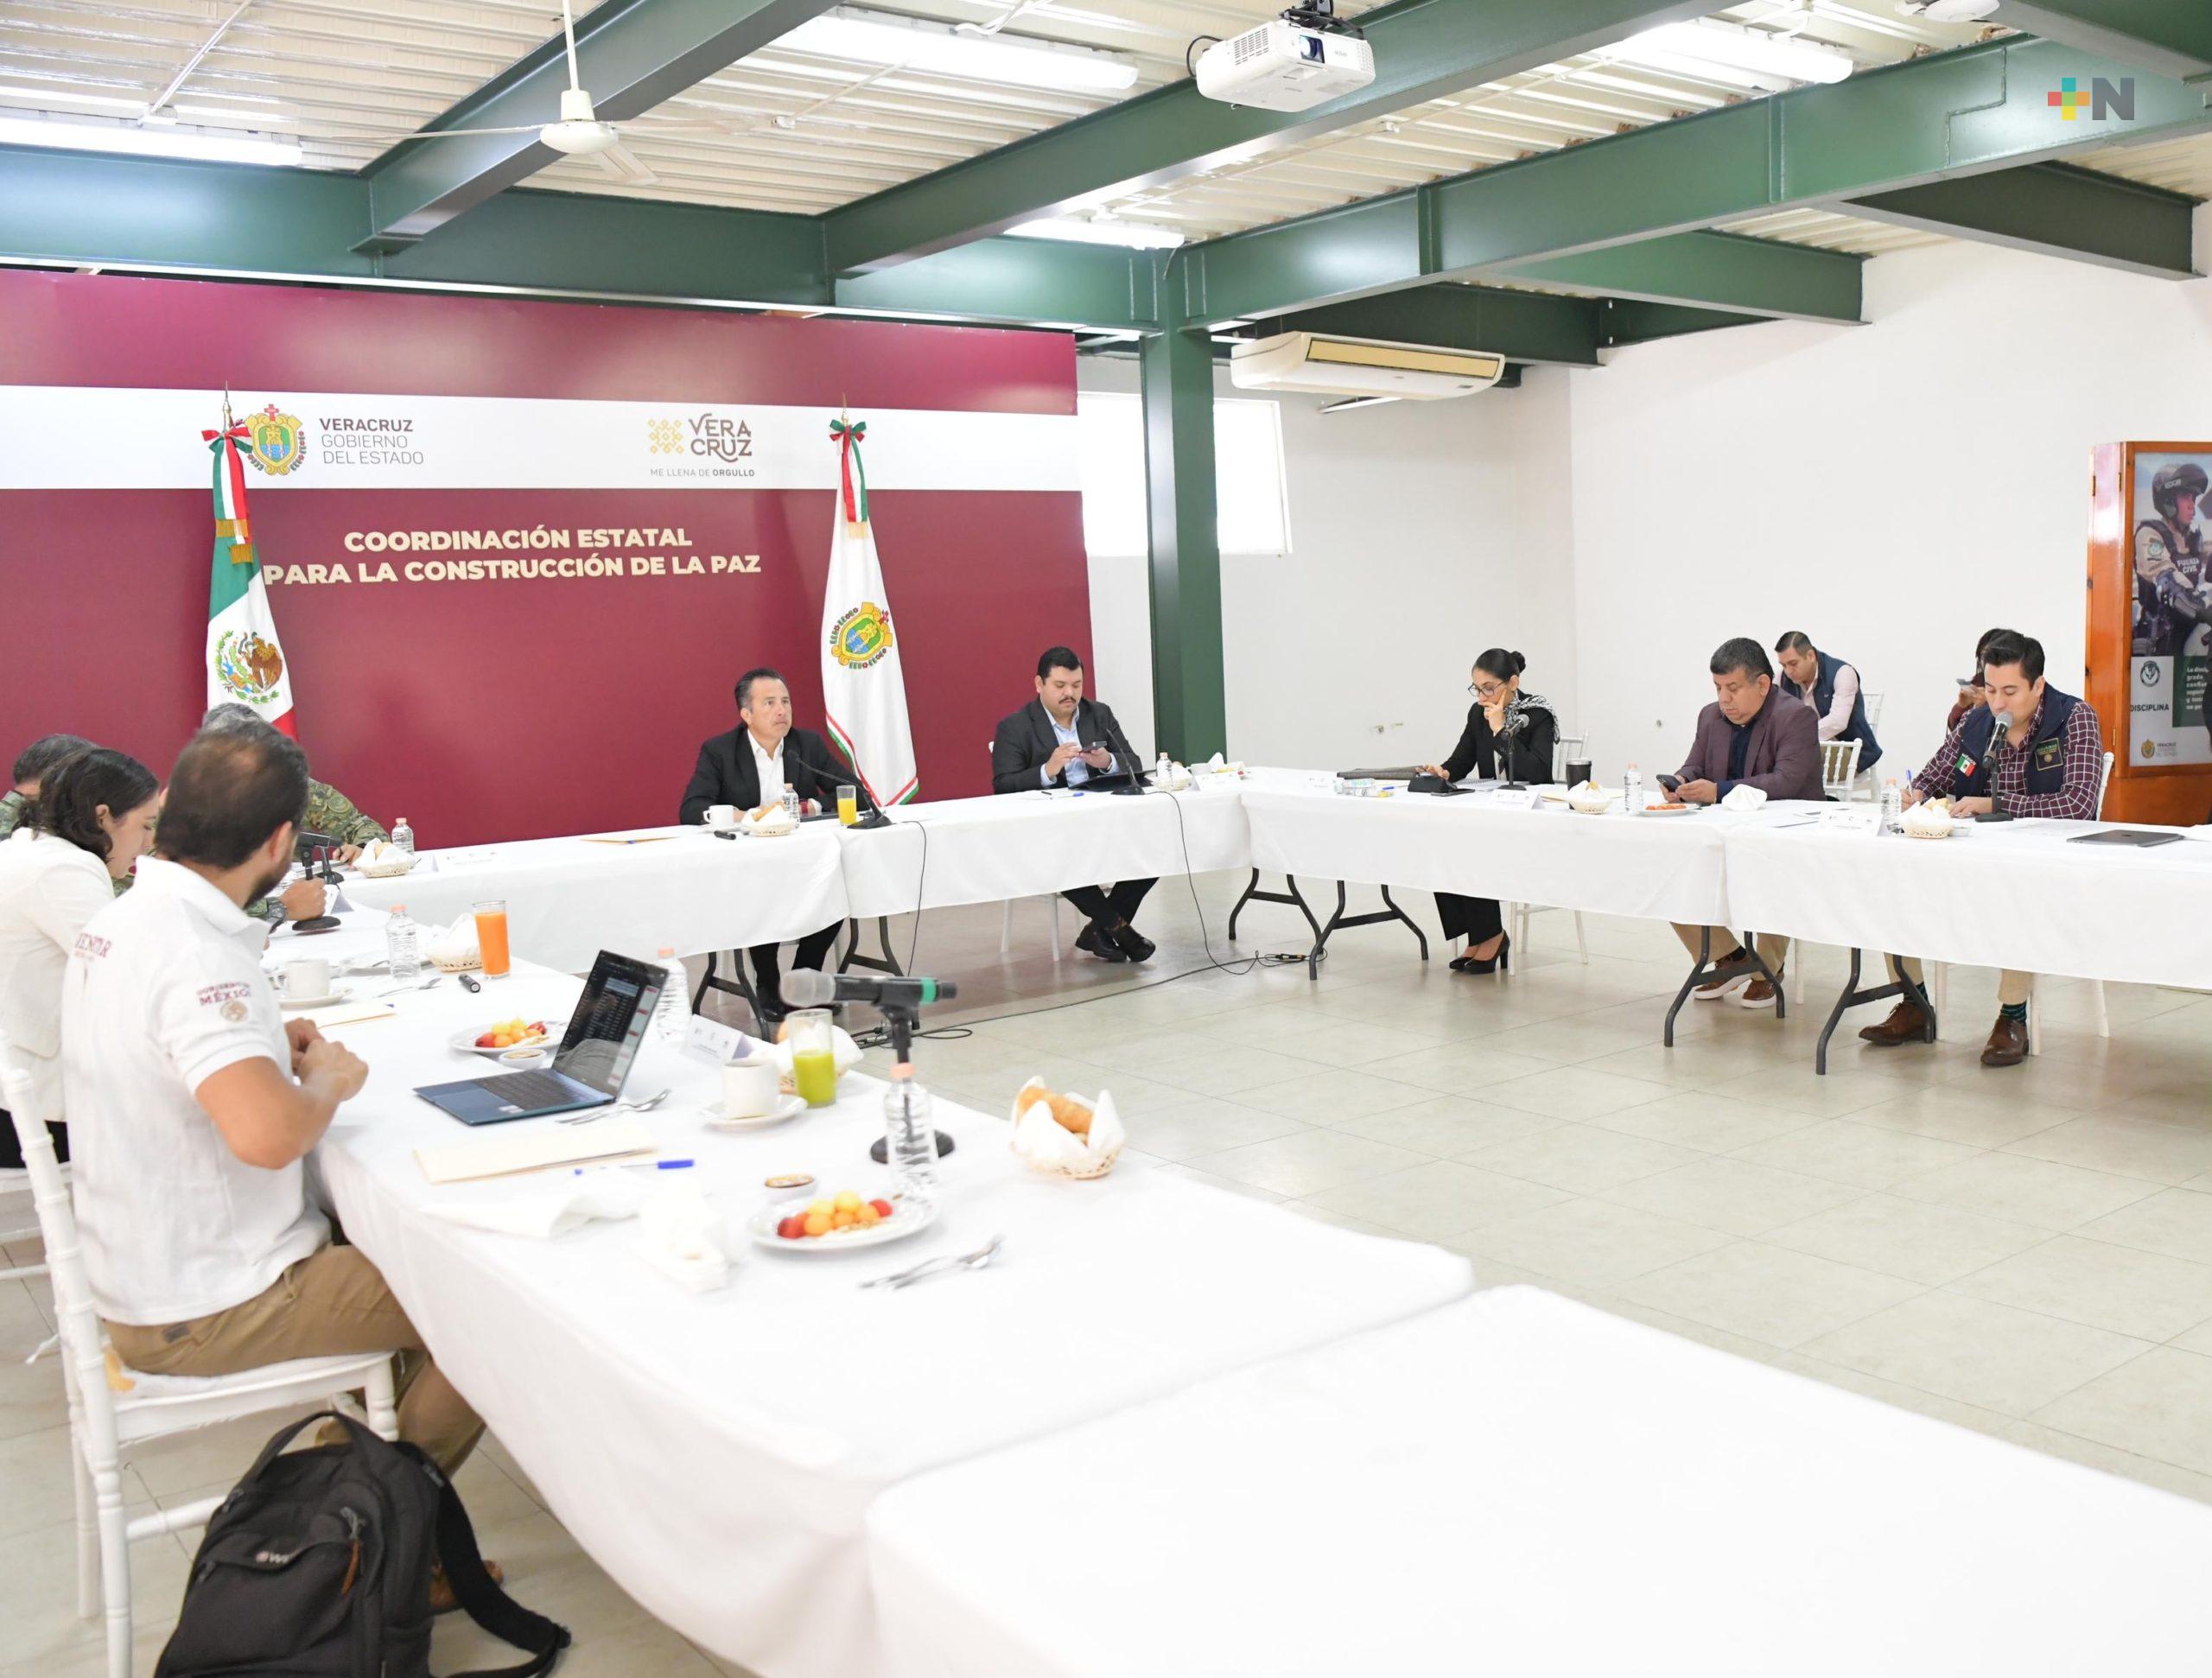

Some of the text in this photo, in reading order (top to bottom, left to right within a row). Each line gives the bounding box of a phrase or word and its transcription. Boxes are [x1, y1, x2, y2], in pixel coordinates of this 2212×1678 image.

[319, 417, 414, 432] VERACRUZ
[688, 413, 752, 438] VERA
[321, 433, 409, 448] GOBIERNO
[323, 449, 424, 465] DEL ESTADO
[690, 437, 753, 463] CRUZ
[650, 468, 755, 477] ME LLENA DE ORGULLO
[344, 524, 693, 553] COORDINACIÓN ESTATAL
[263, 552, 761, 586] PARA LA CONSTRUCCIÓN DE LA PAZ
[2129, 703, 2170, 712] DISCIPLINA
